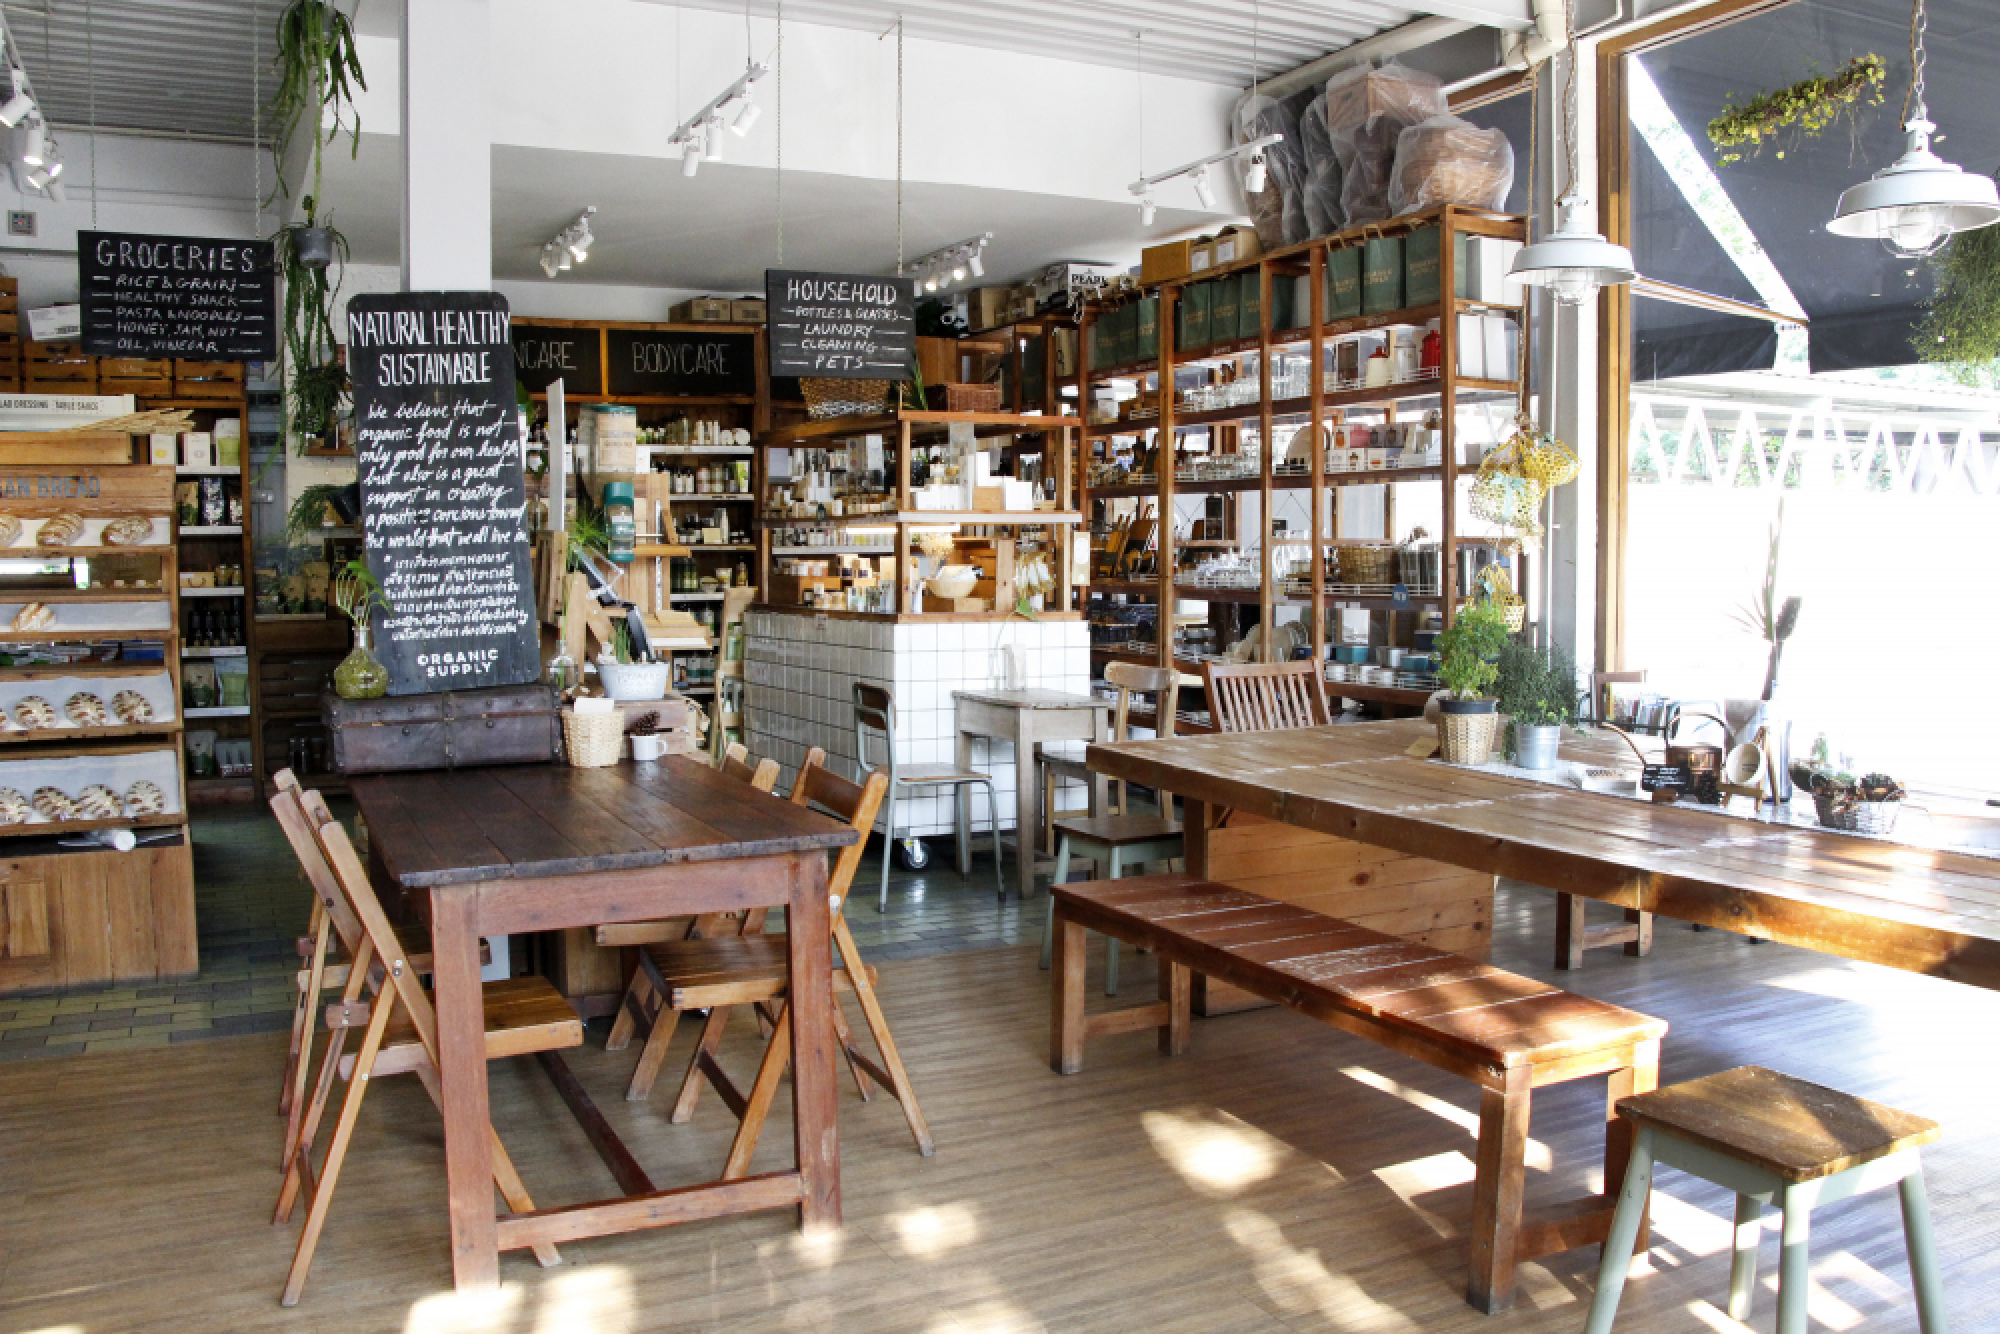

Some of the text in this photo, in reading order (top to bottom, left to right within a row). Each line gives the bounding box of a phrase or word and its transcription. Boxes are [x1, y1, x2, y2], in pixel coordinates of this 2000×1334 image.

[95, 239, 254, 272] GROCERIES
[115, 274, 159, 288] RICE
[787, 278, 897, 306] HOUSEHOLD
[113, 291, 238, 307] HEALTHY SNACK
[115, 306, 163, 320] PASTA
[349, 309, 511, 348] NATURAL HEALTHY
[803, 322, 875, 339] LAUNDRY
[153, 340, 219, 353] VINEGAR
[801, 338, 879, 354] CLEANING
[377, 351, 493, 387] SUSTAINABLE
[631, 341, 731, 375] BODYCARE
[815, 353, 863, 370] PETS
[13, 399, 49, 409] DRESSING
[394, 401, 450, 419] believe
[452, 397, 498, 417] that
[358, 409, 517, 449] organic food is not
[359, 444, 391, 471] only
[392, 441, 427, 467] good
[428, 440, 449, 465] for
[476, 439, 519, 459] health
[362, 464, 400, 487] but
[402, 464, 435, 483] also
[435, 465, 449, 481] is
[451, 467, 462, 481] a
[37, 476, 101, 499] BREAD
[365, 485, 427, 510] support
[425, 483, 441, 501] in
[365, 514, 375, 527] a
[365, 531, 385, 549] the
[387, 526, 426, 549] world
[427, 526, 463, 549] that
[457, 532, 473, 547] we
[471, 525, 489, 544] all
[490, 526, 511, 544] live
[416, 648, 499, 667] ORGANIC
[426, 661, 493, 679] SUPPLY
